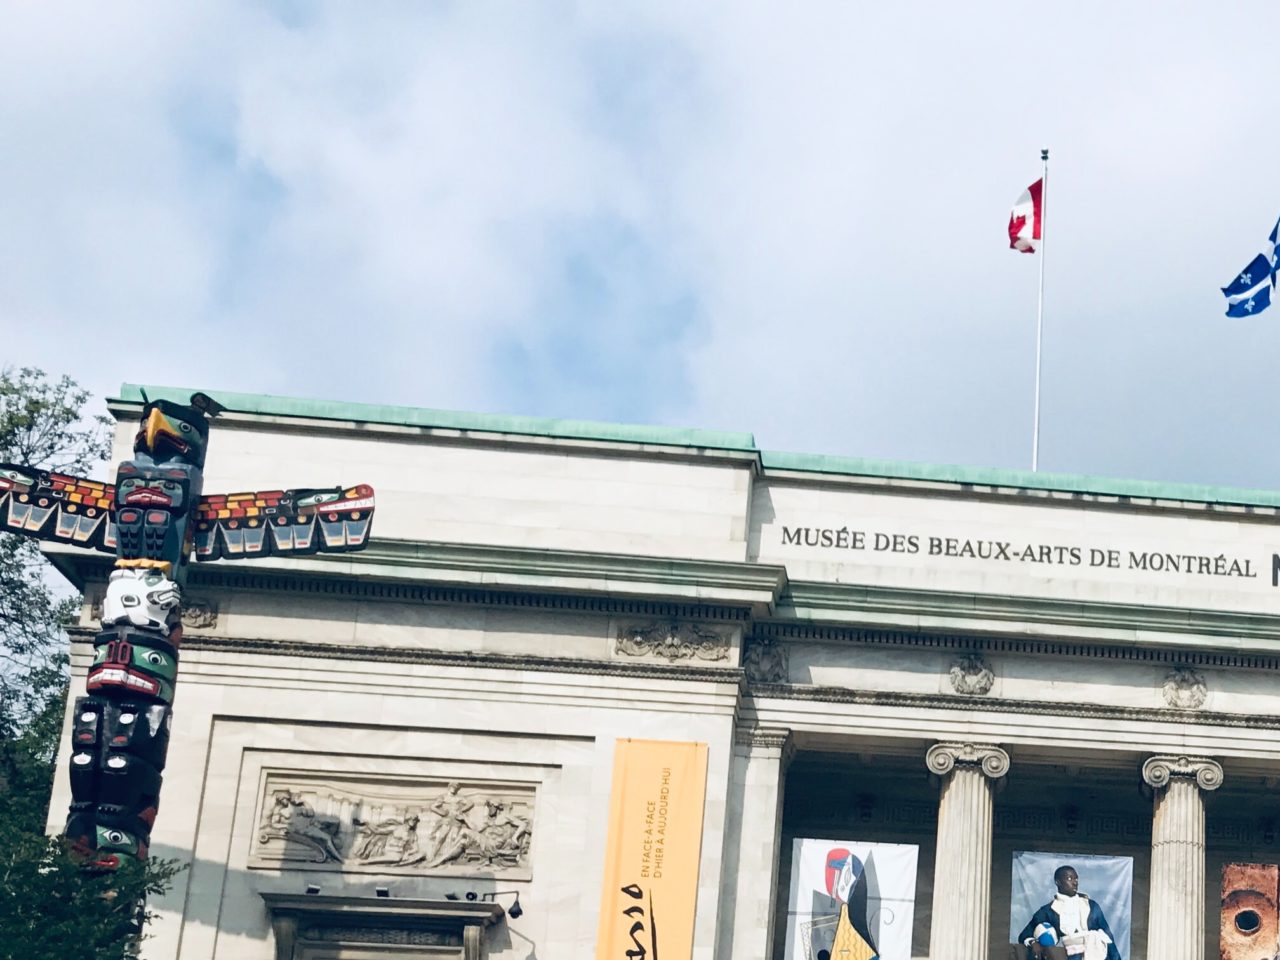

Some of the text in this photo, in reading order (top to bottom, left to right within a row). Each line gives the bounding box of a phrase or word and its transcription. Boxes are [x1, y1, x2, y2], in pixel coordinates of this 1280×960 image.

[781, 526, 1257, 578] MUSÉE DES BEAUX-ARTS DE MONTRÉAL
[641, 866, 650, 877] EN
